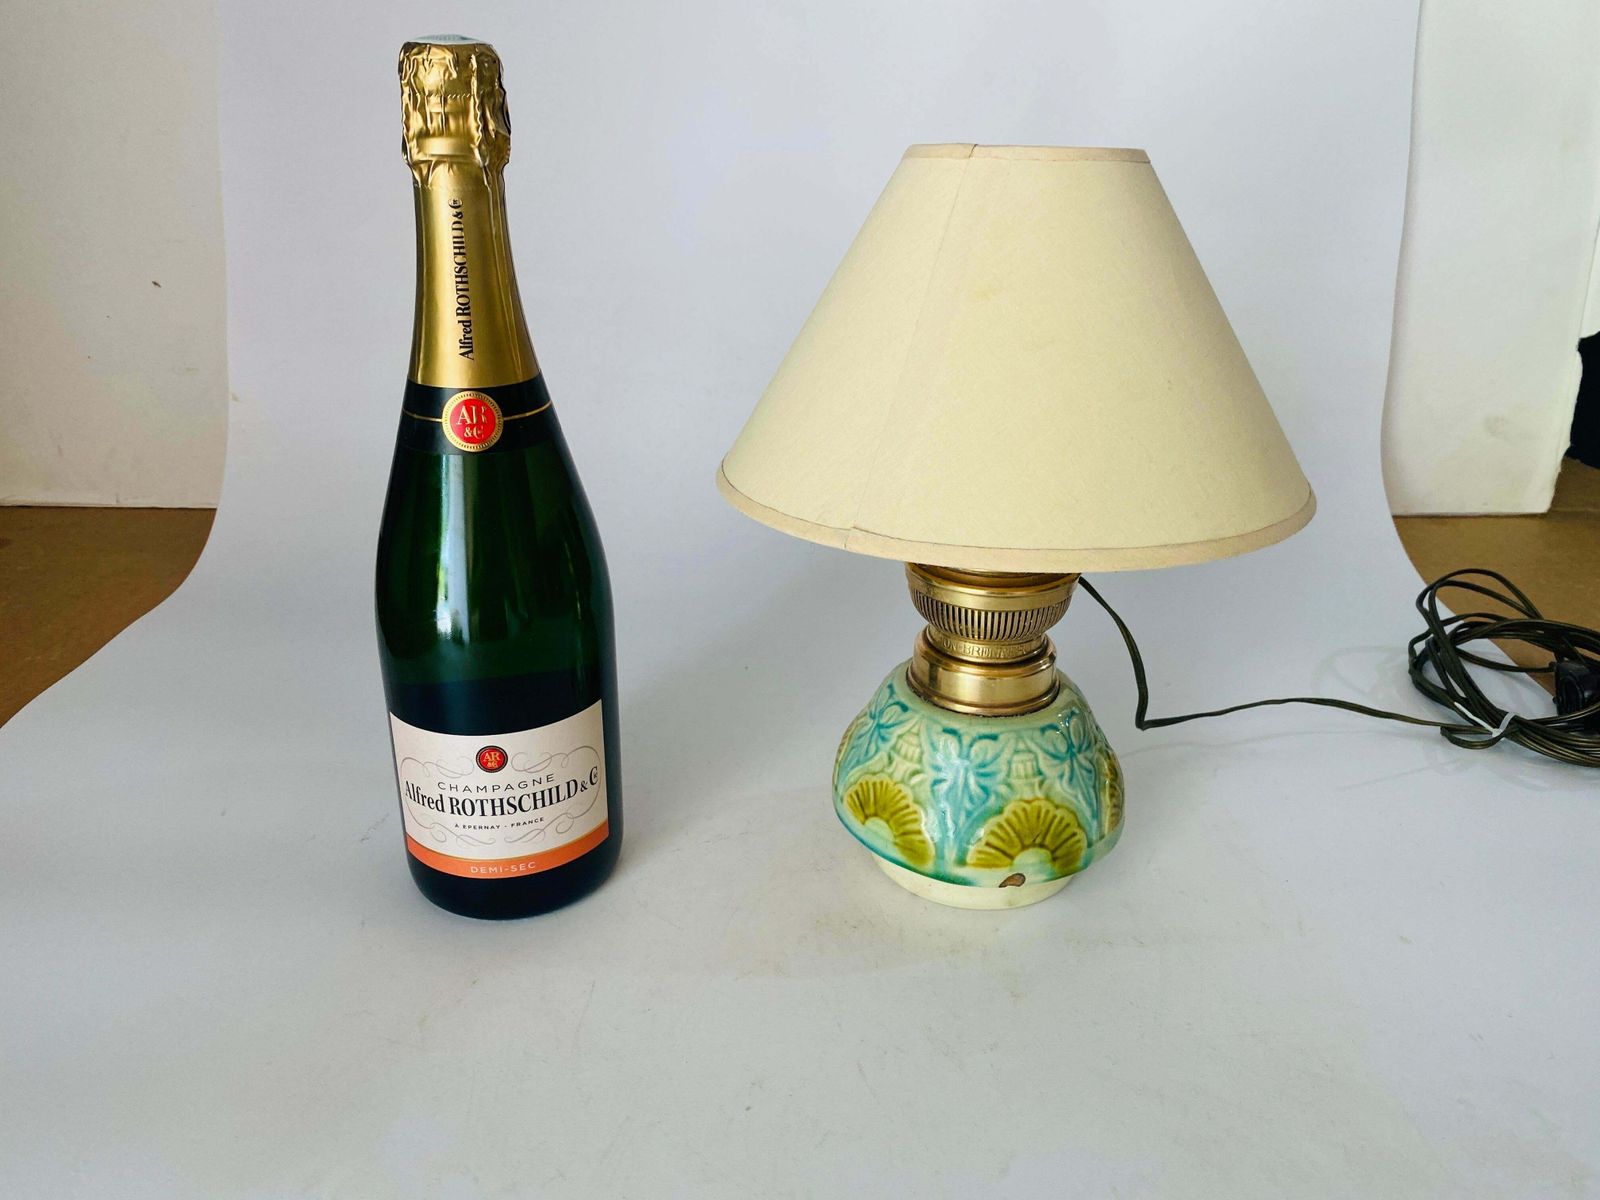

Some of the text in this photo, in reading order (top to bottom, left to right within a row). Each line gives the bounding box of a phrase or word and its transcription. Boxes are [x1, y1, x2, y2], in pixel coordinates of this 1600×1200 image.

[451, 220, 472, 317] ROTHSCHILD
[458, 319, 475, 361] Alfred
[483, 751, 501, 762] AR
[437, 773, 555, 794] CHAMPAGNE
[405, 780, 446, 813] Alfred
[448, 778, 578, 817] ROTHSCHILD
[580, 780, 588, 792] &
[510, 816, 545, 828] FRANCE
[470, 861, 537, 874] DEMI-SEC
